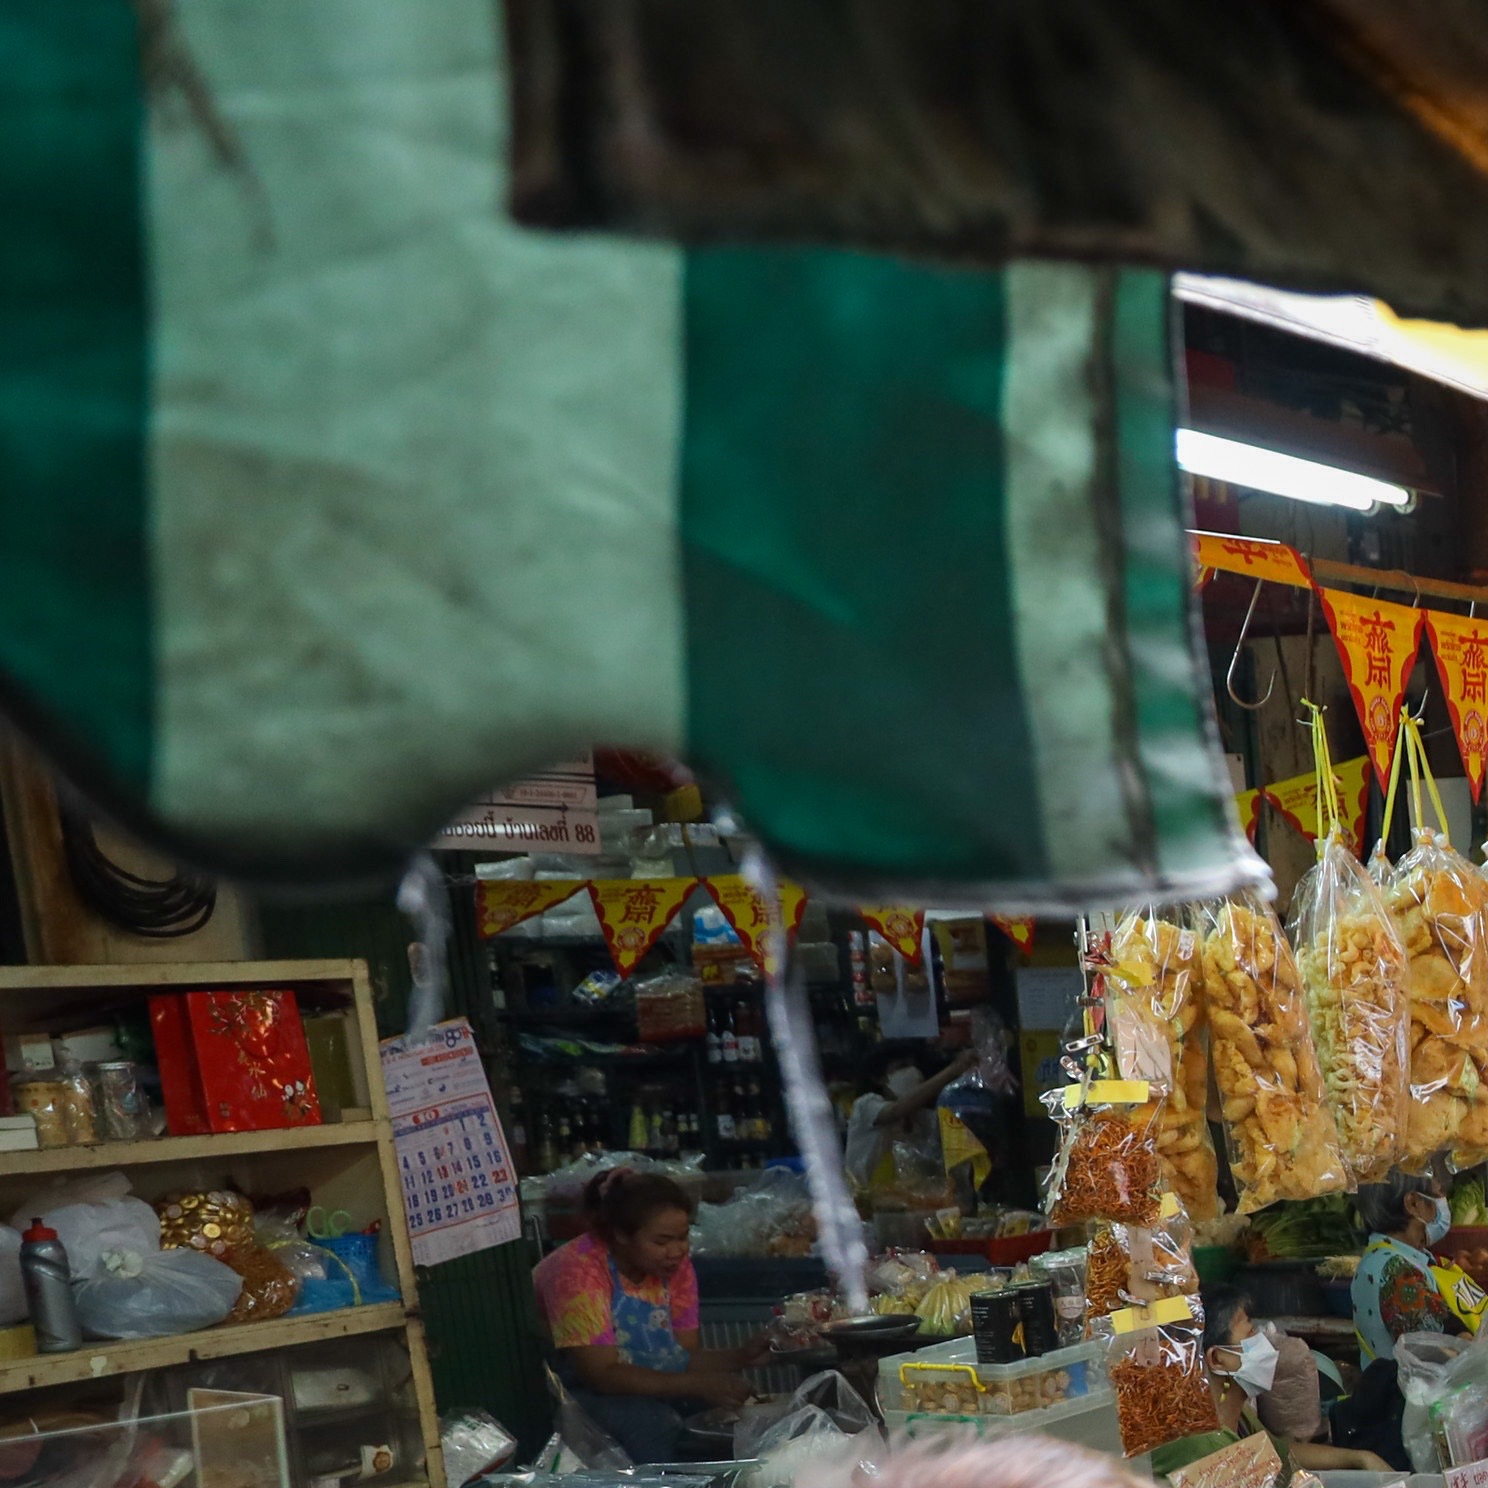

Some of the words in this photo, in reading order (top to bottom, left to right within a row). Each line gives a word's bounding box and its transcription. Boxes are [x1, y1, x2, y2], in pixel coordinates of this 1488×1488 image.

[575, 823, 595, 843] 88
[460, 1118, 467, 1131] 1
[478, 1113, 487, 1127] 2
[403, 1156, 410, 1170] 4
[418, 1151, 426, 1166] 5
[447, 1142, 454, 1156] 7
[464, 1137, 472, 1151] 8
[484, 1132, 493, 1146] 9
[405, 1175, 415, 1189] 11
[422, 1170, 434, 1184] 12
[467, 1155, 481, 1170] 15
[487, 1150, 501, 1165] 16
[407, 1194, 419, 1209] 18
[425, 1189, 437, 1203] 19
[443, 1184, 454, 1199] 20
[471, 1174, 488, 1189] 22
[492, 1169, 508, 1184] 23
[410, 1214, 423, 1229] 25
[427, 1208, 442, 1223] 26
[446, 1203, 458, 1218] 27
[463, 1198, 475, 1213] 28
[477, 1192, 493, 1207] 29
